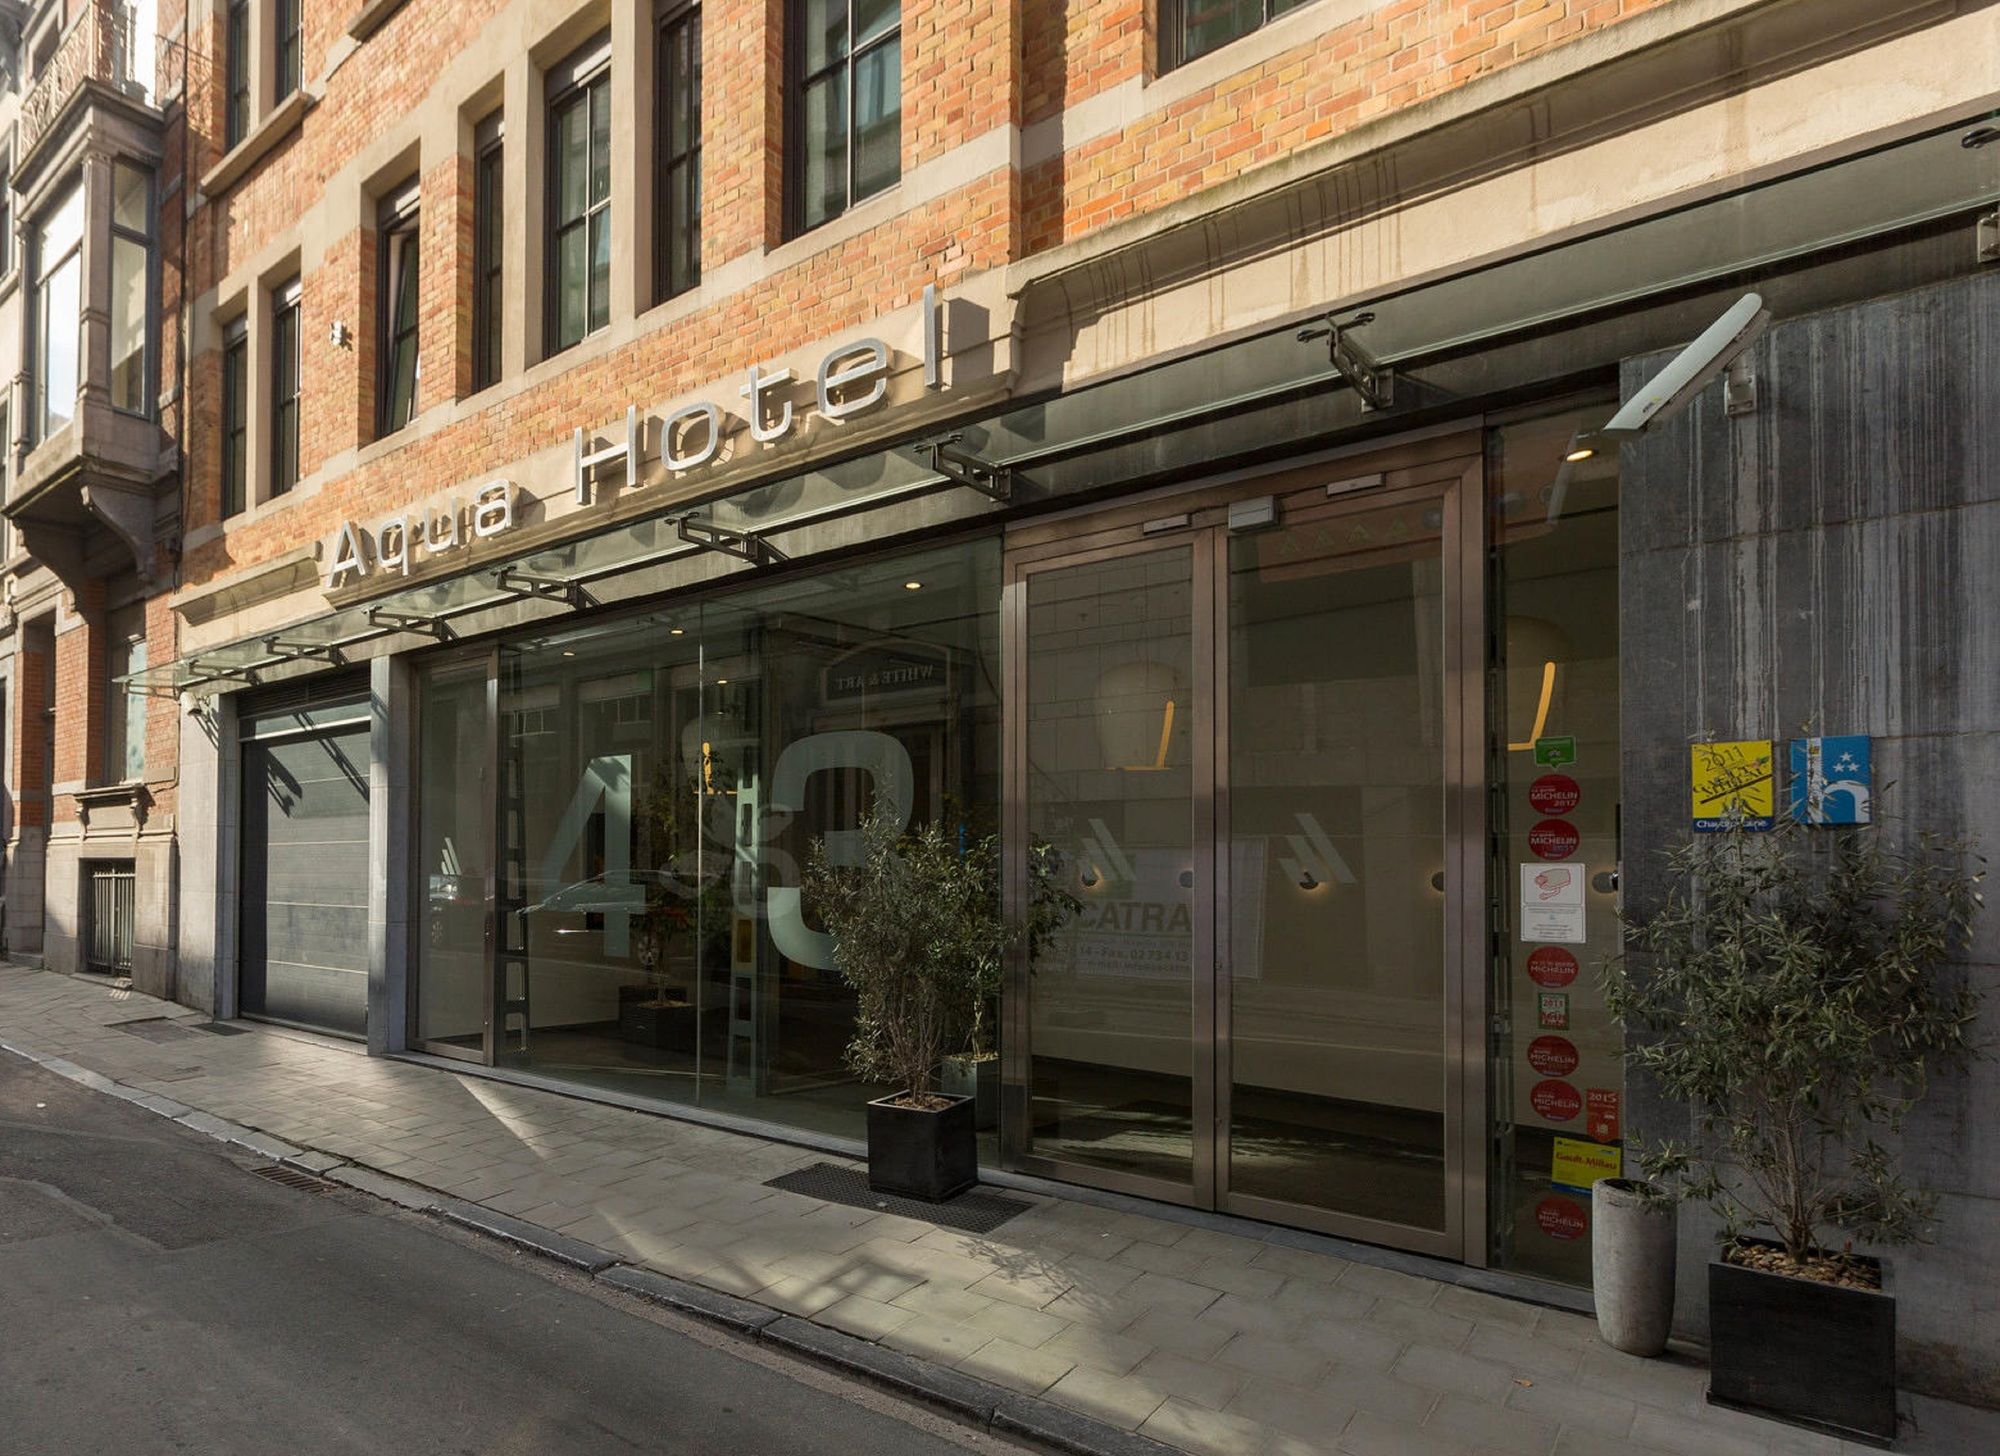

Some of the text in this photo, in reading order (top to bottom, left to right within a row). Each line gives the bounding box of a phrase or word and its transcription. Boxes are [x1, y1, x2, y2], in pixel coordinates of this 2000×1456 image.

[327, 282, 939, 588] Aqua Hotel
[1702, 745, 1745, 772] 2011
[1531, 791, 1578, 800] MICHELIN
[1530, 836, 1577, 845] MICHELIN
[1530, 965, 1575, 974] MICHELIN
[1530, 1054, 1576, 1064] MICHELIN
[1533, 1098, 1580, 1108] MICHELIN
